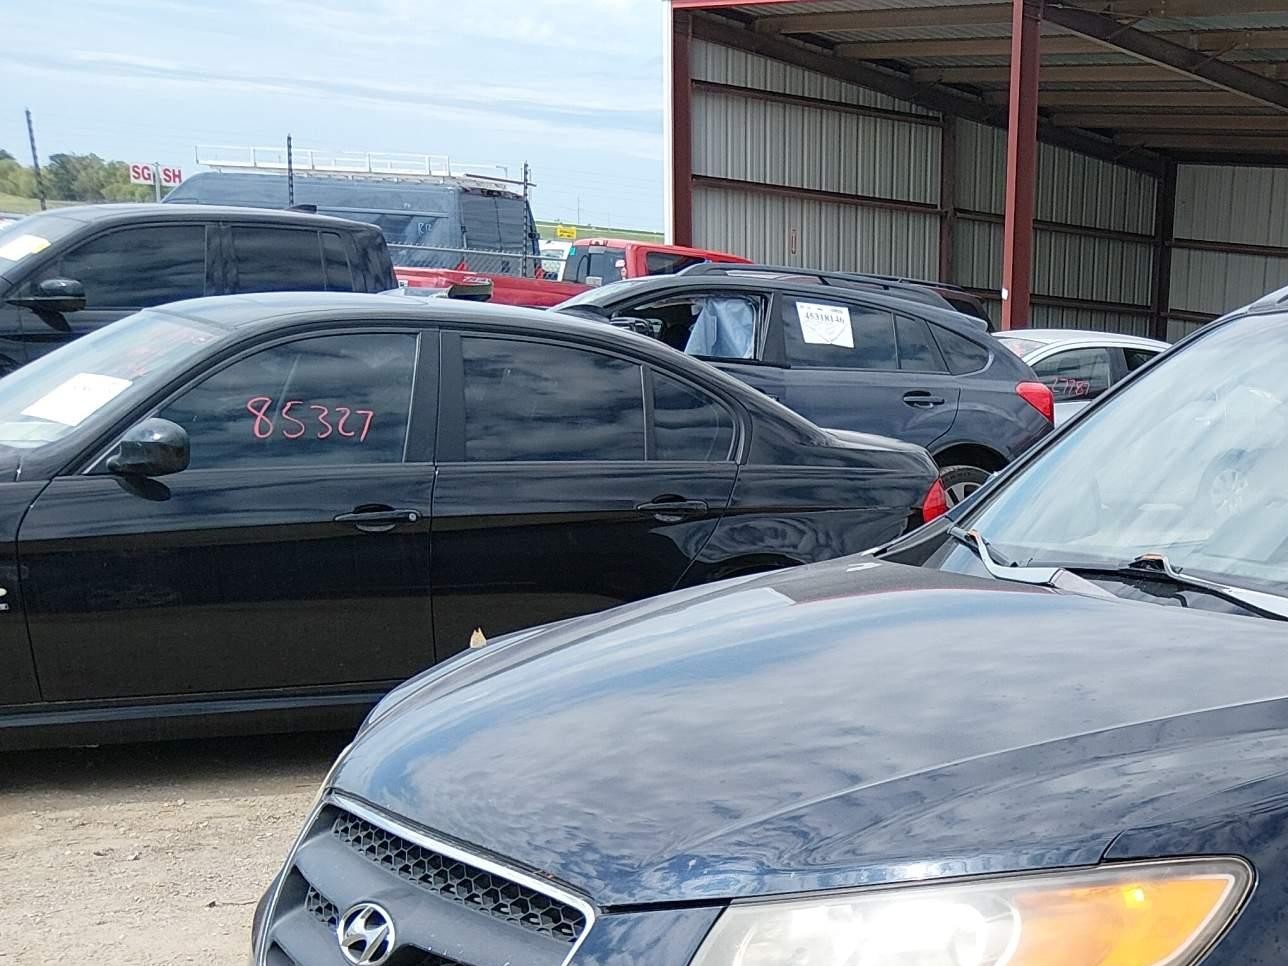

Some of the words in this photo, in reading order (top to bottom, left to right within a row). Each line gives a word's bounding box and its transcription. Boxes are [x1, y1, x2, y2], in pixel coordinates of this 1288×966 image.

[132, 165, 152, 181] SG
[163, 168, 182, 184] SH
[247, 397, 374, 442] 85327
